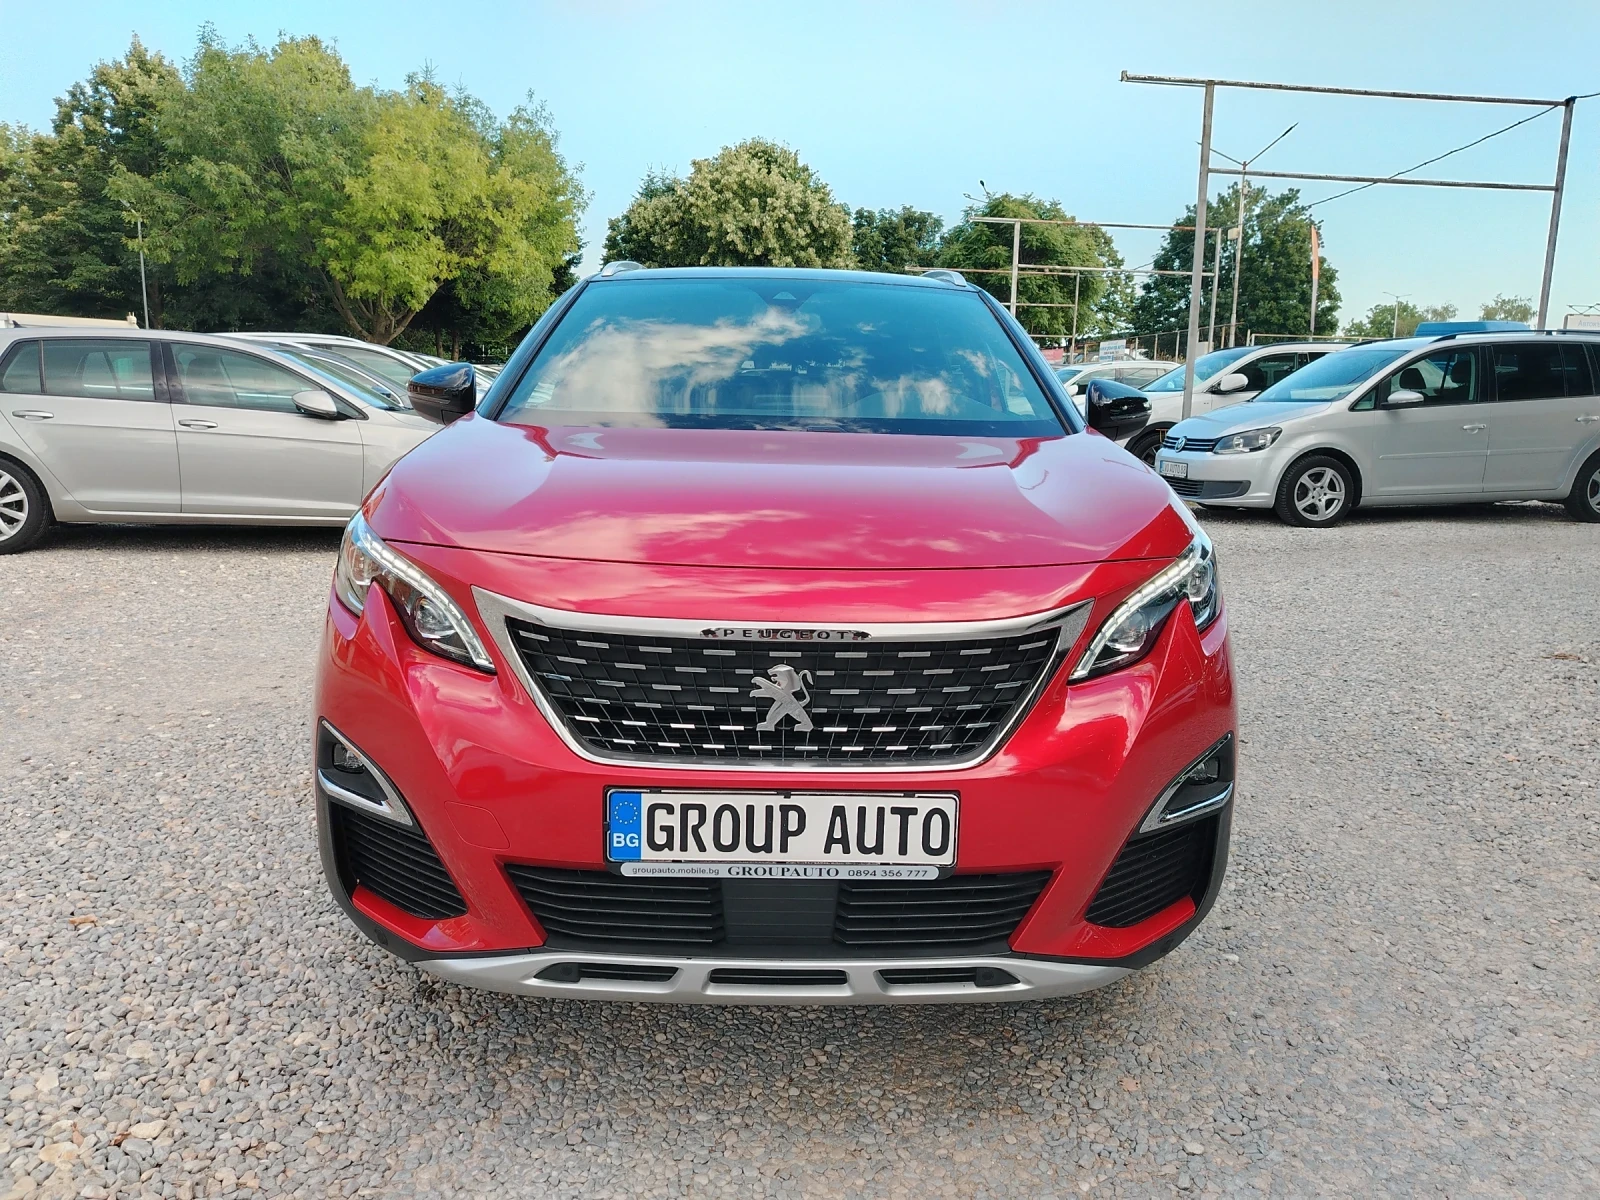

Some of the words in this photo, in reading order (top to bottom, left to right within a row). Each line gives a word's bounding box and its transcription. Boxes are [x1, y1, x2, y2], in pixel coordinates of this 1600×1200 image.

[723, 629, 850, 640] PEUGEOT
[646, 802, 807, 854] GROUP
[823, 805, 951, 857] AUTO
[613, 833, 639, 847] BG
[632, 866, 720, 876] groupauto.mobile.bg
[727, 866, 840, 877] GROUPAUTO
[848, 869, 877, 877] 0894
[881, 869, 902, 877] 356
[906, 870, 928, 878] 777
